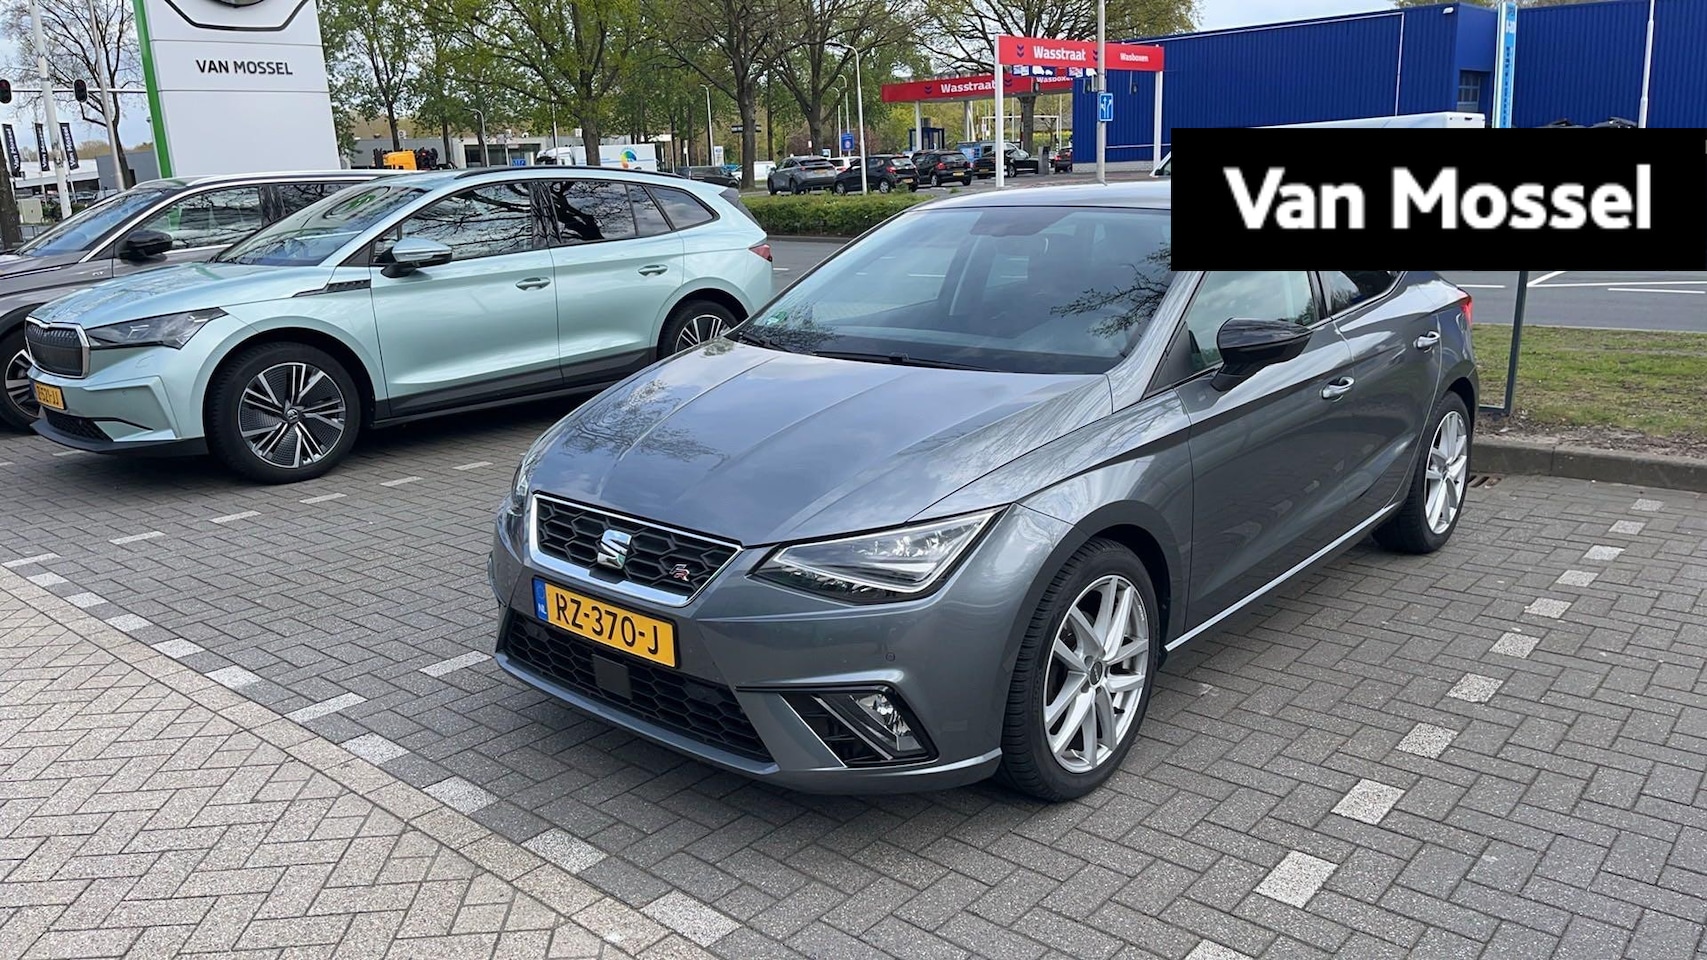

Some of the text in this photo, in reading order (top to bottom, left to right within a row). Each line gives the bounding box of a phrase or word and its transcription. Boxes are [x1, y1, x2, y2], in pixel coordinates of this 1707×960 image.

[1033, 45, 1087, 61] Wasstraat
[1119, 52, 1149, 63] Wasboxen
[195, 59, 294, 75] VAN MOSSEL
[537, 592, 660, 656] NL RZ-370-J
